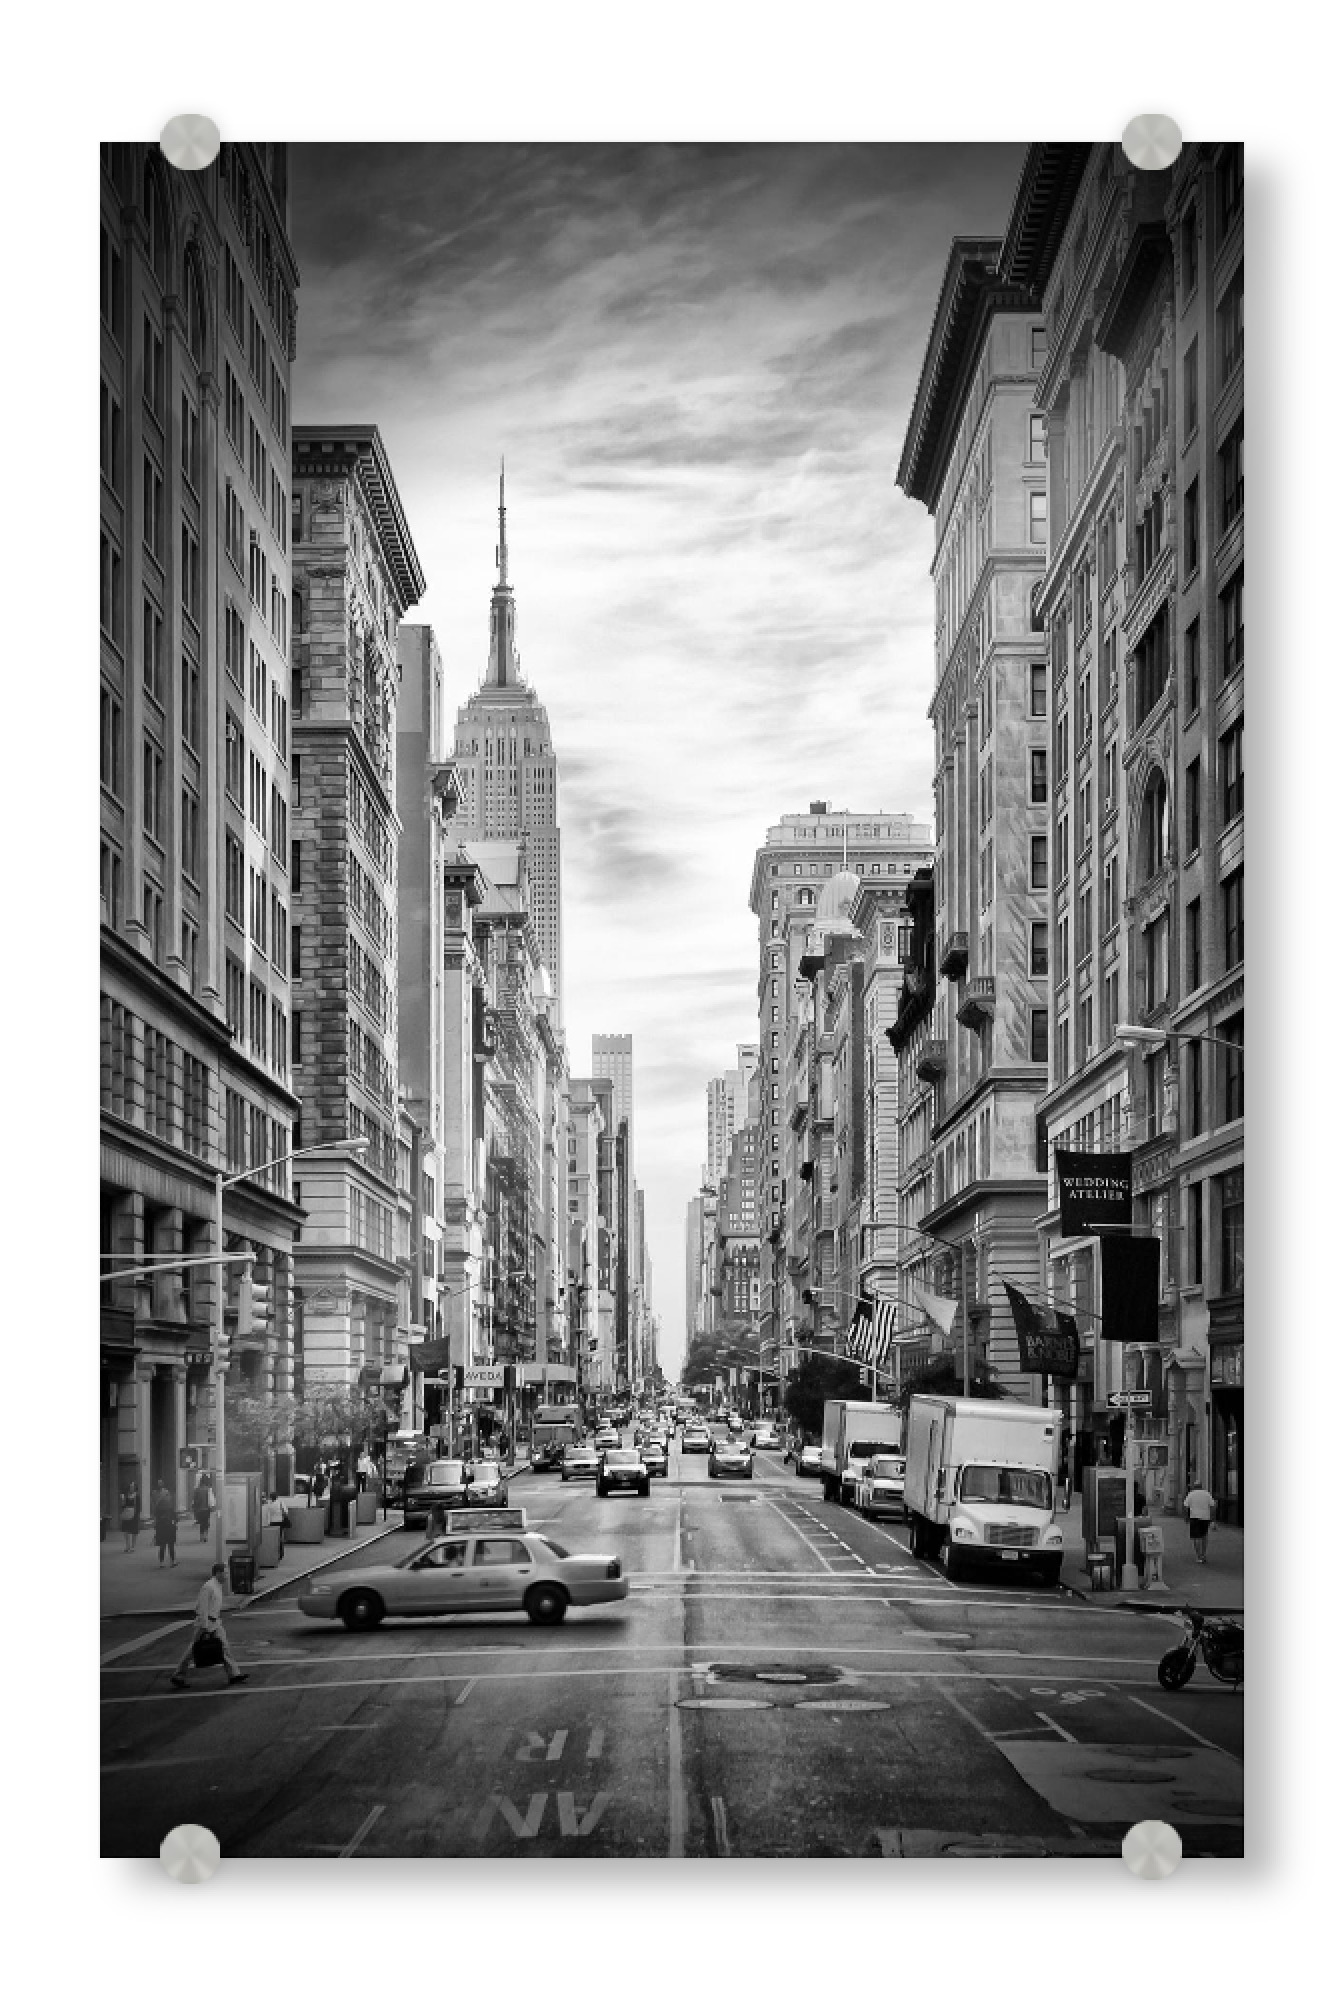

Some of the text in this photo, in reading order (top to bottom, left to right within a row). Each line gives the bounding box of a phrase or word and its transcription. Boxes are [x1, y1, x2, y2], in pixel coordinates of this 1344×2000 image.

[1063, 1177, 1129, 1189] WEDDING
[1069, 1189, 1125, 1200] ATELIER
[464, 1371, 502, 1380] AVEDA
